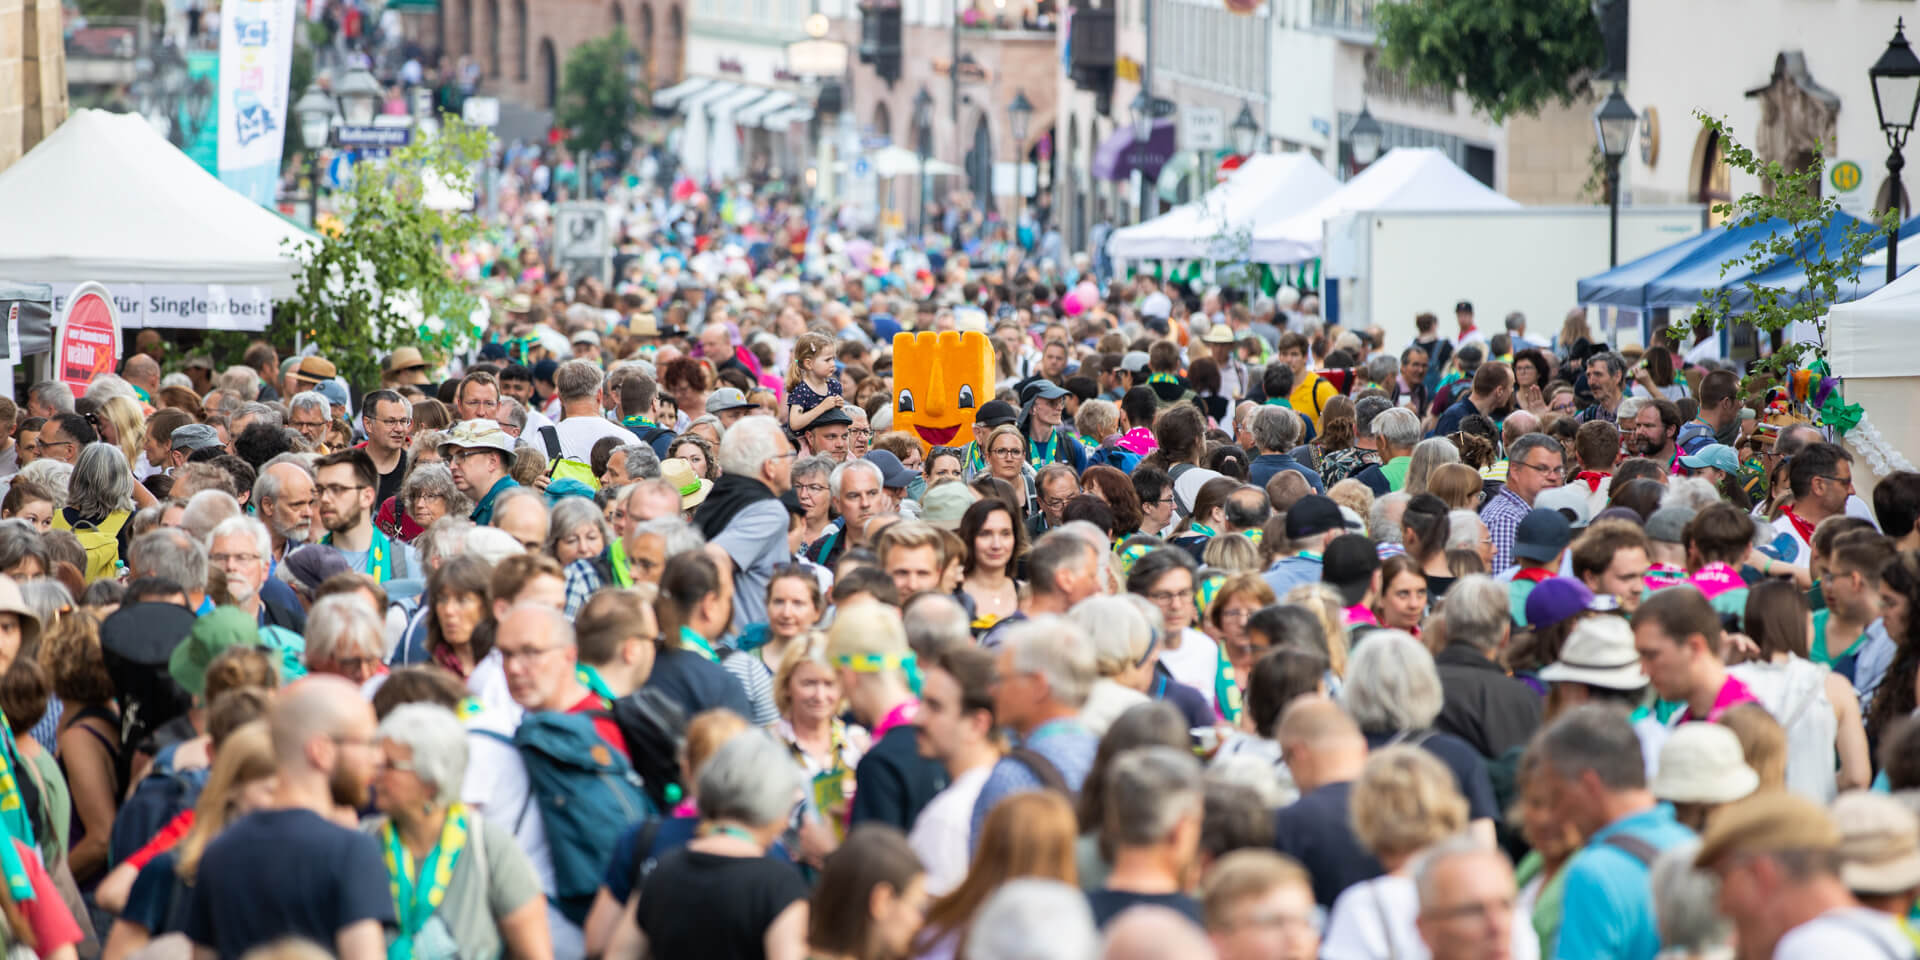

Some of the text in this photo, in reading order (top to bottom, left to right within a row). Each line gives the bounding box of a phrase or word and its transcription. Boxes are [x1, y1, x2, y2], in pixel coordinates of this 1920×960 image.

[149, 296, 266, 316] Singlearbeit
[67, 343, 95, 367] wählt
[1695, 572, 1729, 583] HELFE
